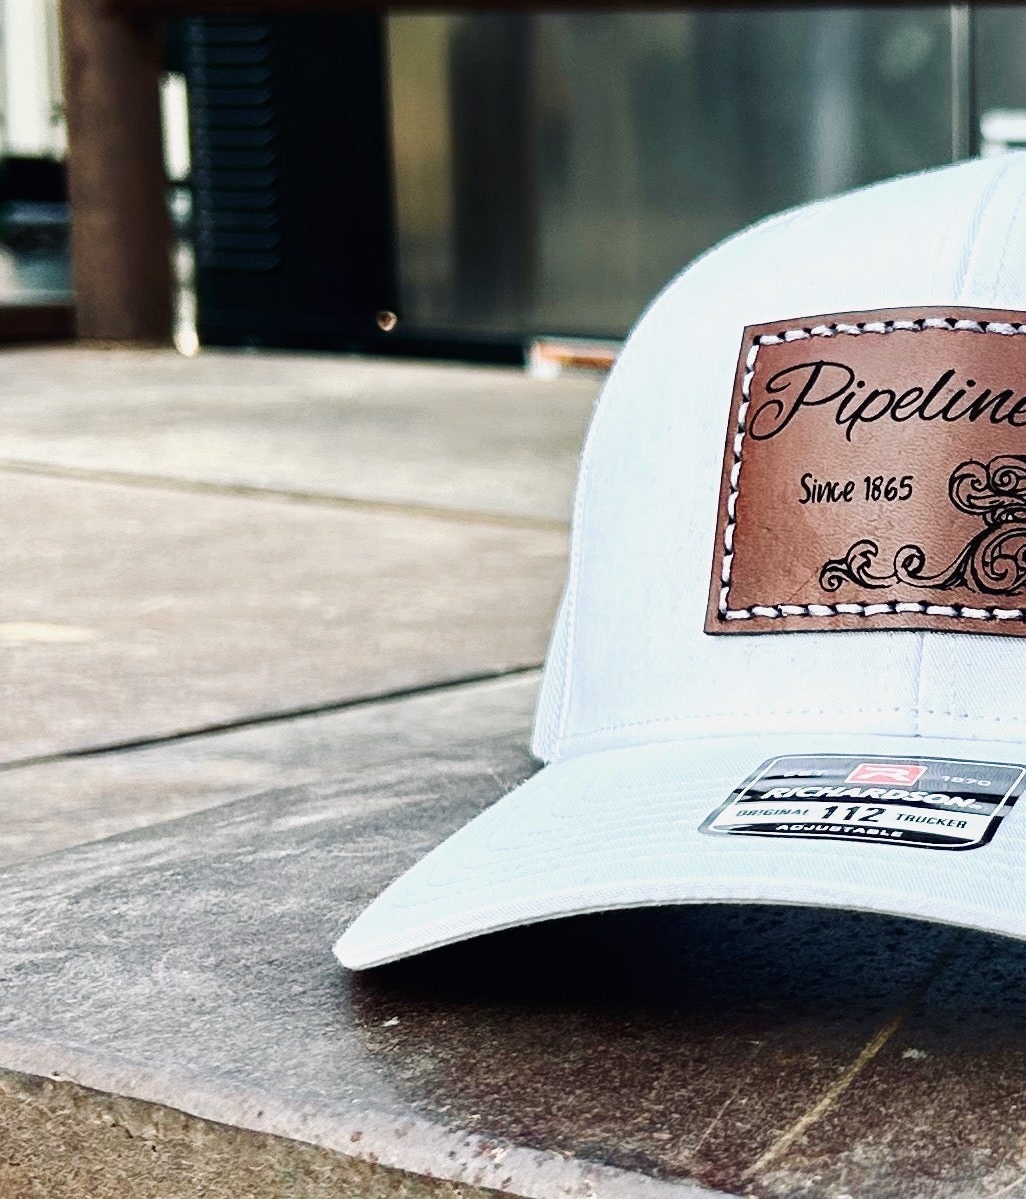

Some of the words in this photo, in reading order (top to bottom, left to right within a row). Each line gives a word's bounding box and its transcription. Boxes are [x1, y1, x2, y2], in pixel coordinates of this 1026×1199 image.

[799, 472, 855, 504] Since
[864, 474, 914, 502] 1865
[760, 786, 977, 808] RICHARDSON
[735, 808, 810, 817] ORIGINAL
[821, 805, 887, 823] 112
[896, 812, 968, 829] TRUCKER
[775, 824, 905, 838] ADJUSTABLE
